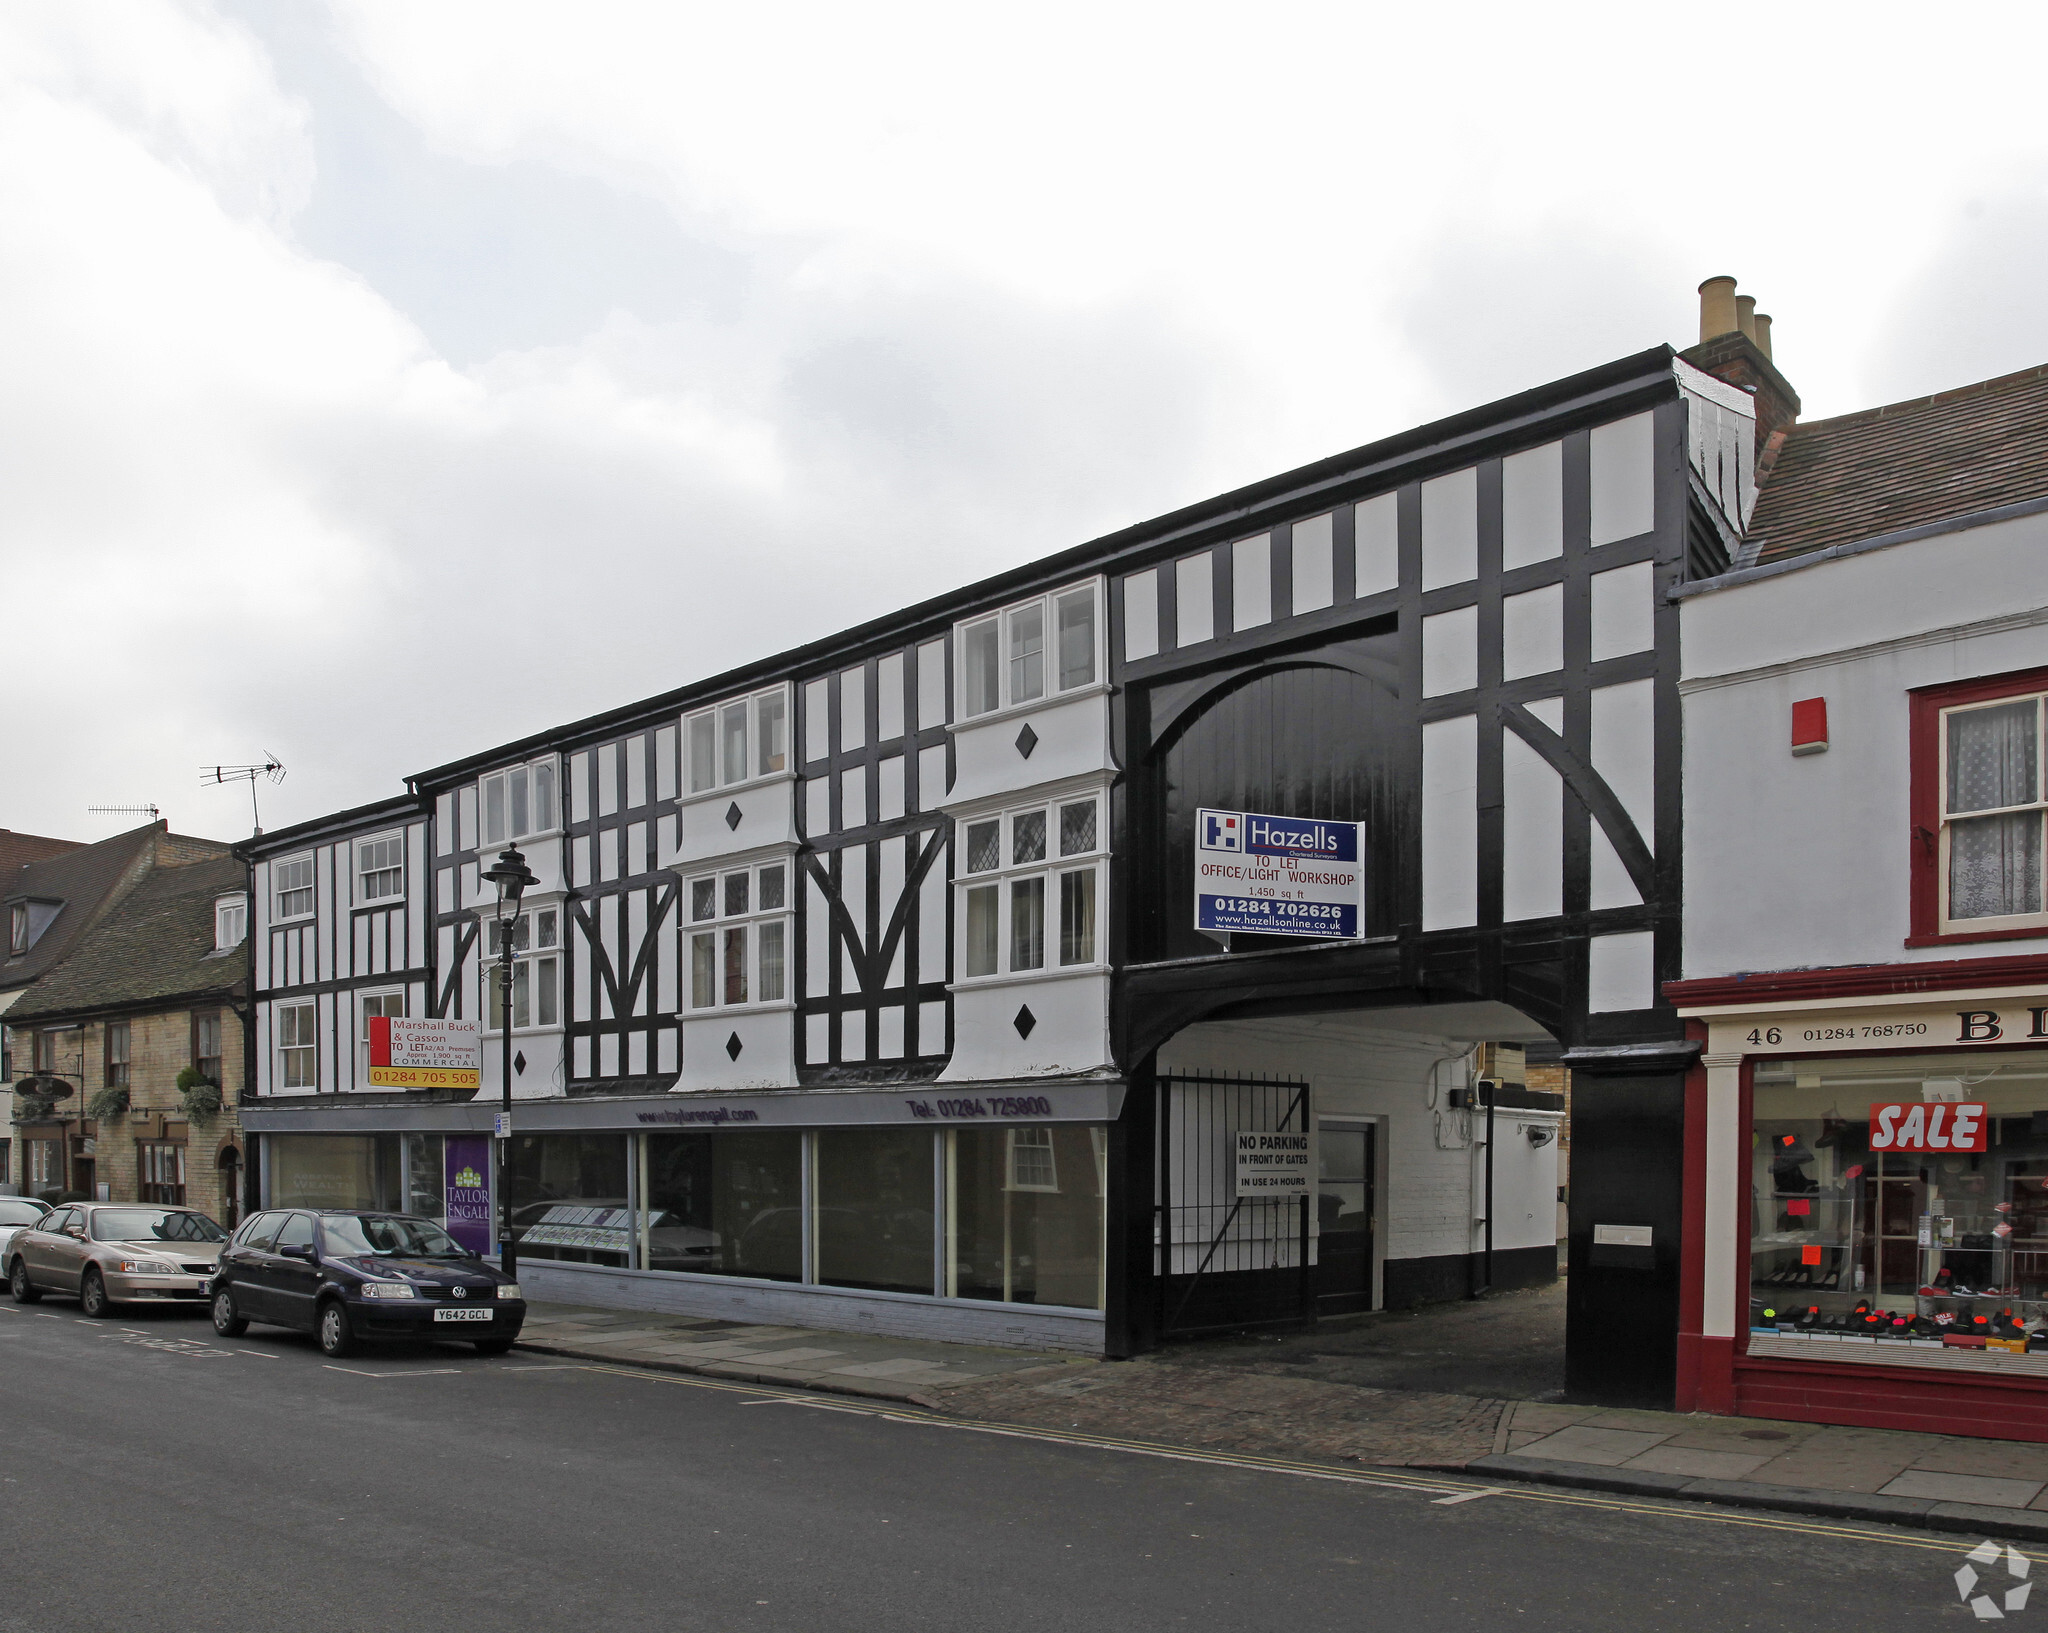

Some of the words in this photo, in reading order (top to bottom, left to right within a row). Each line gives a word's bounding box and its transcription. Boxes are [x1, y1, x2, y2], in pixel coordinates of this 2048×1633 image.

[1252, 821, 1338, 851] Hazells
[1289, 850, 1313, 858] Chartered
[1255, 855, 1270, 867] TO
[1280, 857, 1299, 869] LET
[1201, 863, 1280, 881] OFFICE/LIGHT
[1288, 870, 1354, 886] WORKSHOP
[1249, 886, 1275, 897] 1,450
[1281, 889, 1291, 899] sq
[1297, 889, 1304, 899] ft
[1215, 898, 1270, 914] 01284
[1276, 902, 1342, 918] 702626
[1215, 913, 1341, 930] www.hazellsonline.co.uk
[393, 1020, 444, 1031] Marshall
[448, 1022, 476, 1032] Buck
[394, 1033, 402, 1041] &
[406, 1033, 446, 1042] Casson
[1746, 1027, 1783, 1045] 46
[1803, 1028, 1855, 1041] 01284
[1861, 1023, 1927, 1038] 768750
[391, 1042, 404, 1051] TO
[410, 1043, 425, 1052] LET
[393, 1057, 476, 1067] COMMERCIAL
[373, 1071, 417, 1082] 01284
[422, 1072, 447, 1083] 705
[452, 1073, 477, 1084] 505
[937, 1098, 987, 1117] 01284
[986, 1096, 1051, 1116] 725800
[1872, 1104, 1983, 1148] SALE
[1239, 1135, 1256, 1150] NO
[1260, 1136, 1308, 1150] PARKING
[1239, 1154, 1247, 1164] IN
[1249, 1154, 1273, 1164] FRONT
[1275, 1154, 1284, 1164] OF
[1286, 1154, 1308, 1164] GATES
[1241, 1178, 1250, 1186] IN
[1252, 1178, 1267, 1186] USE
[1269, 1177, 1278, 1186] 24
[1280, 1177, 1306, 1186] HOURS
[447, 1186, 489, 1203] TAYLOR
[447, 1203, 490, 1220] ENGALL
[439, 1310, 466, 1320] Y642
[468, 1310, 488, 1319] GCL
